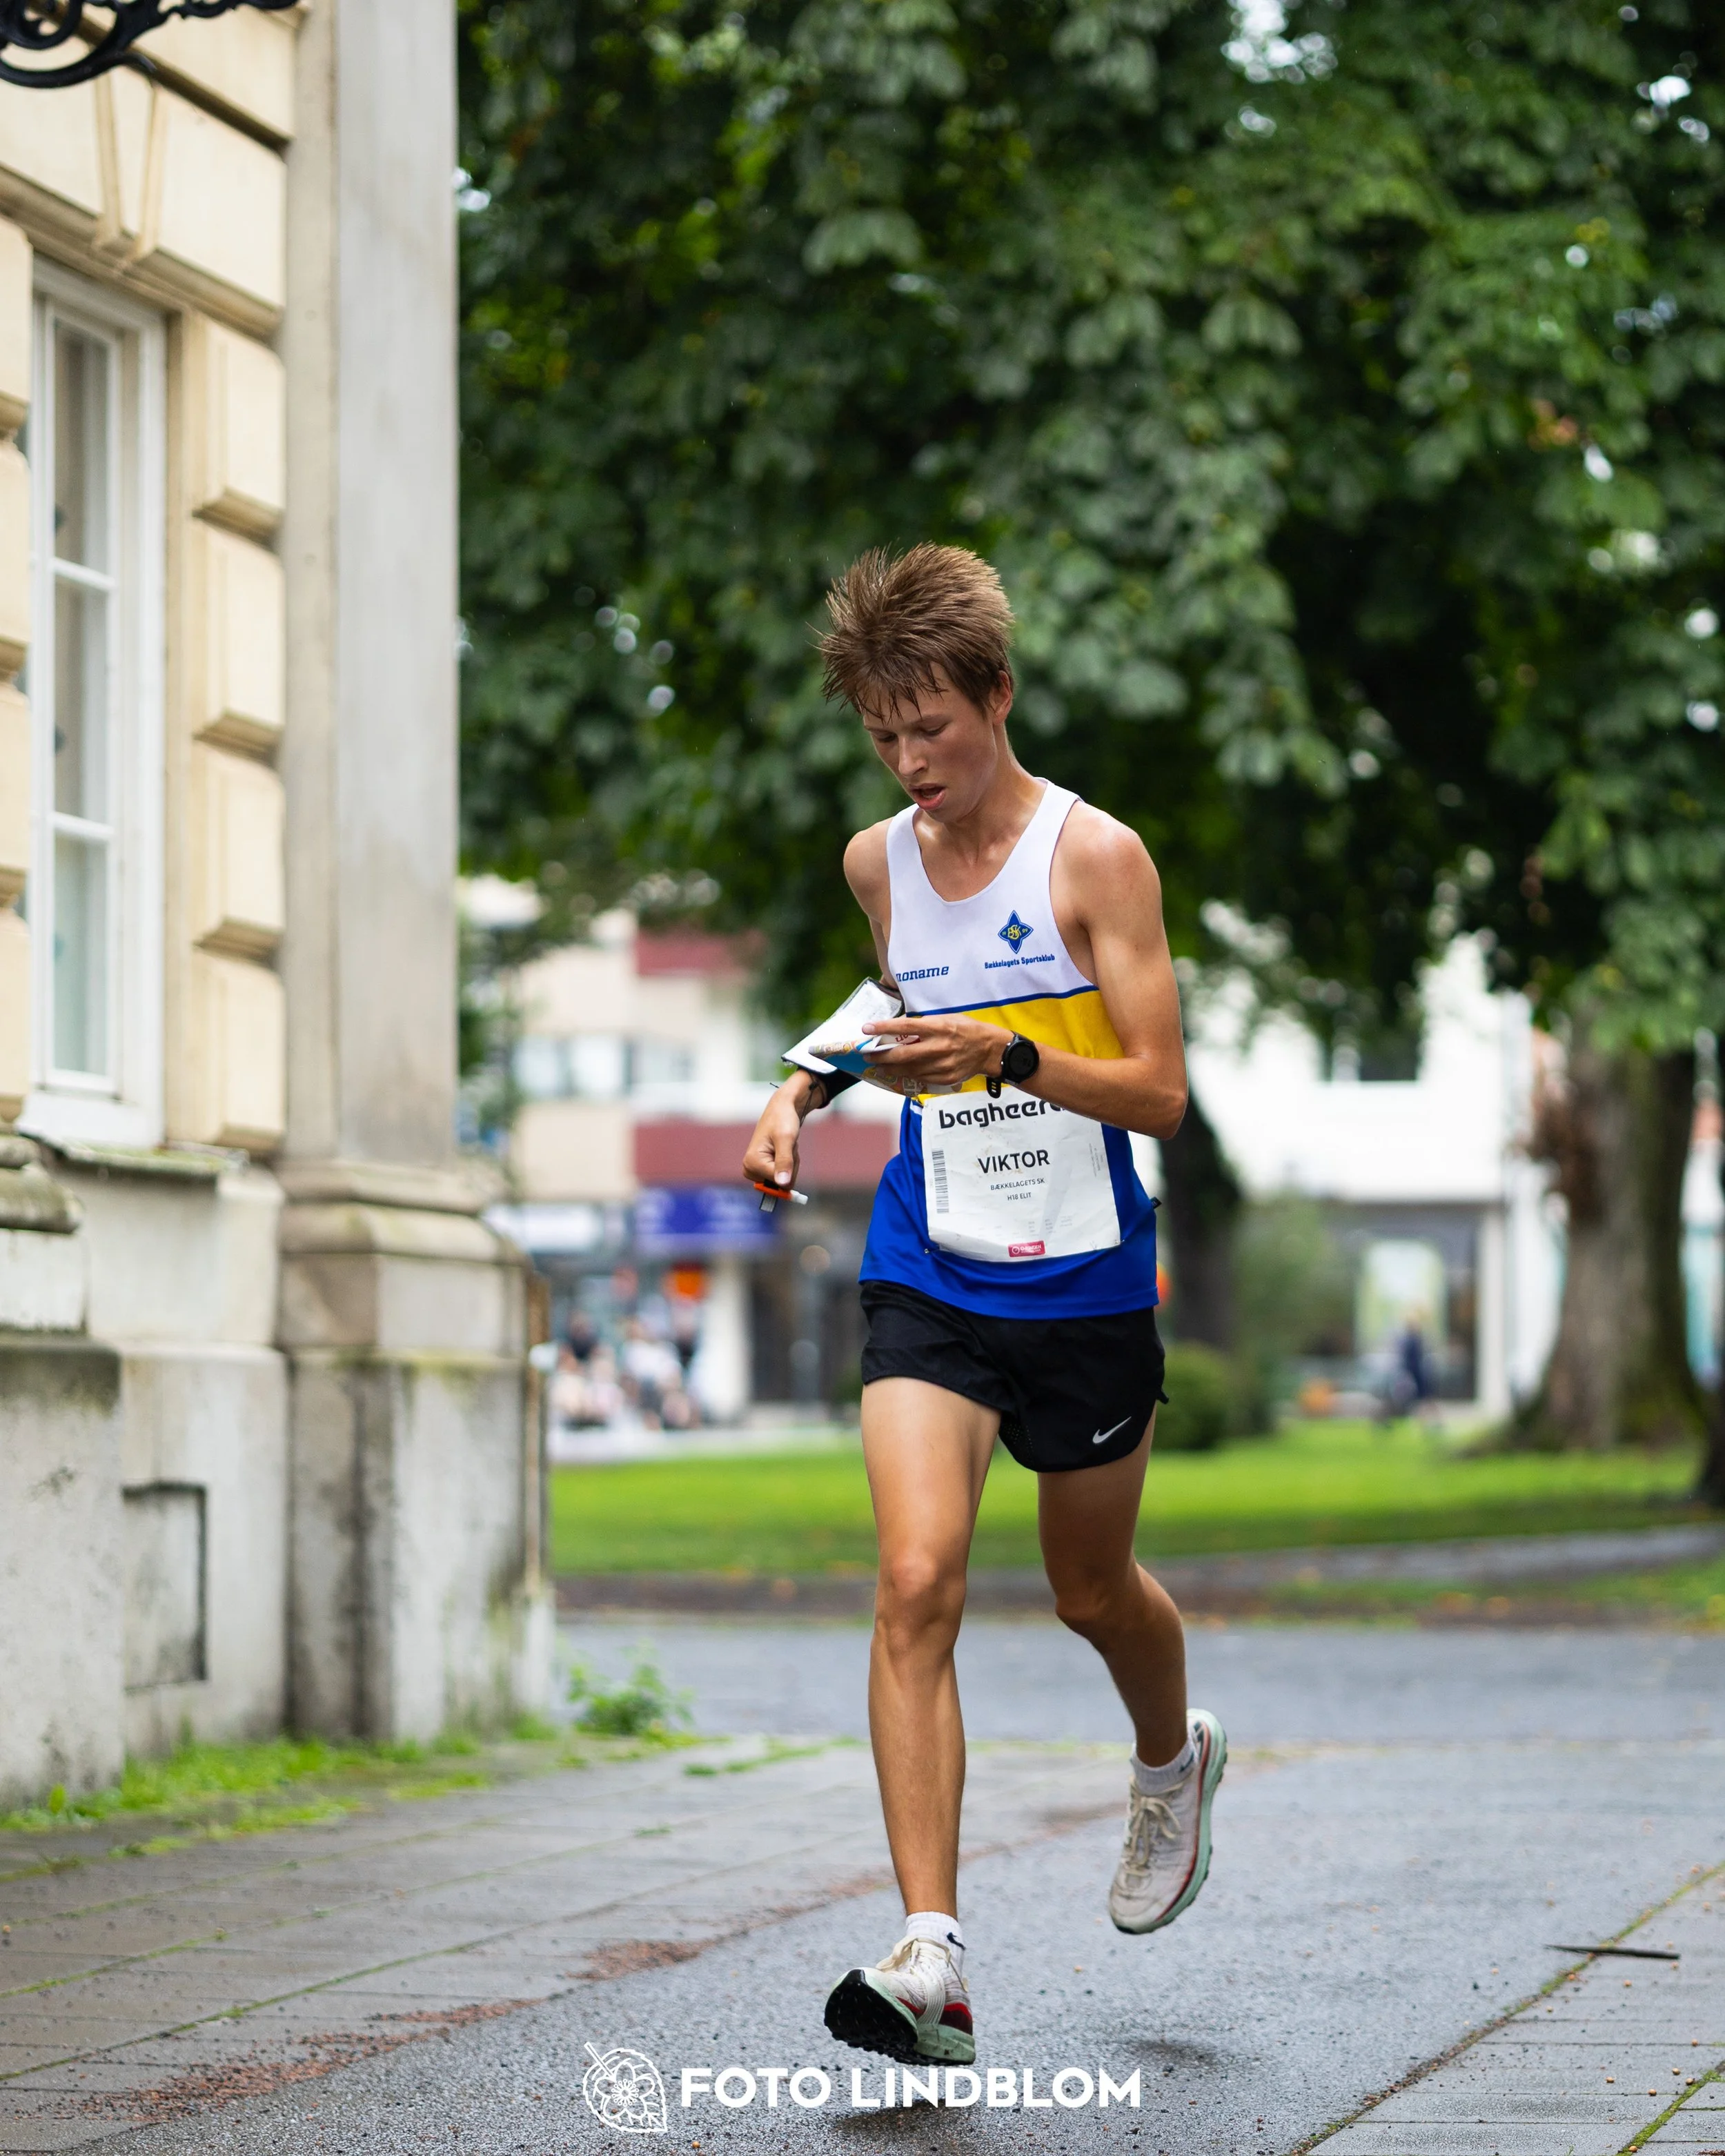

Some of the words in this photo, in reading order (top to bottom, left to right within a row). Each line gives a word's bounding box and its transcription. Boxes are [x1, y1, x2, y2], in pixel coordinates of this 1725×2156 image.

[985, 958, 1020, 969] Bækkelagets
[1021, 953, 1055, 965] Sportsklub
[896, 966, 949, 982] noname
[977, 1149, 1050, 1174] VIKTOR
[990, 1178, 1036, 1191] BÆKKELAGETS
[1020, 1191, 1032, 1200] ELIT
